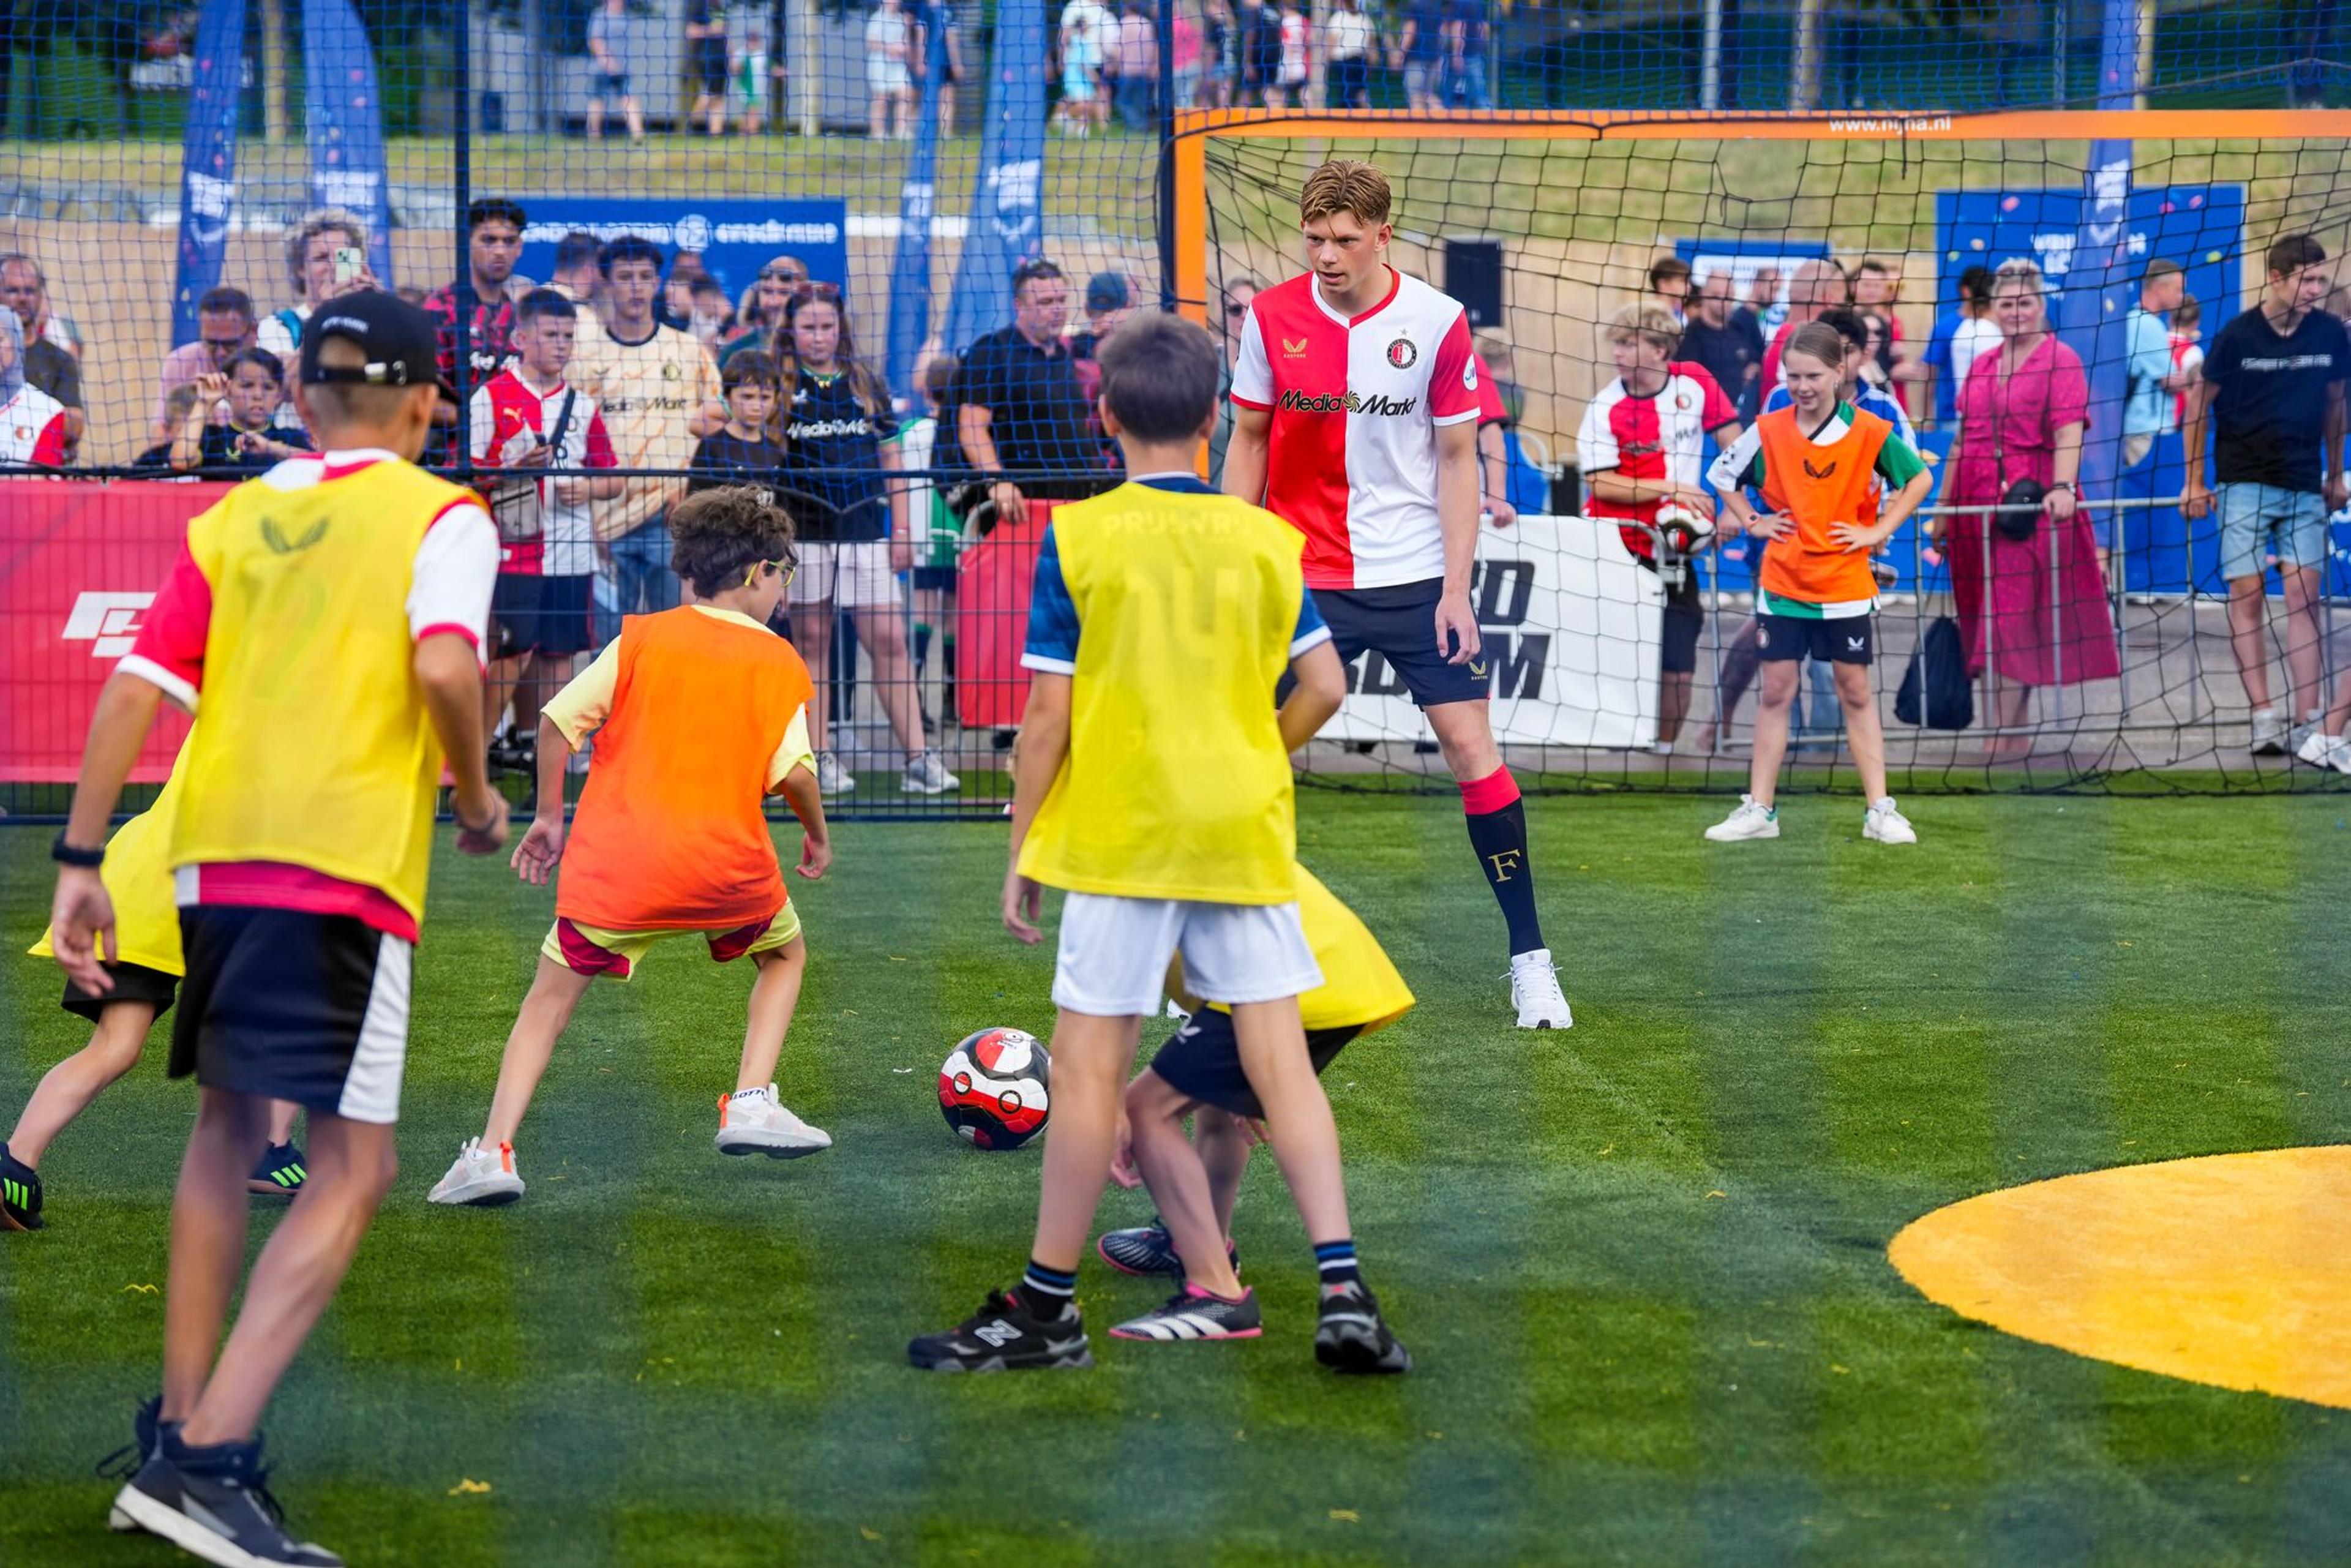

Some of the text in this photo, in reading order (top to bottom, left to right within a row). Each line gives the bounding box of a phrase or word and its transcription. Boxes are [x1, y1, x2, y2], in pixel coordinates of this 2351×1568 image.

[1279, 389, 1416, 416] Media Markt
[1488, 849, 1521, 882] F
